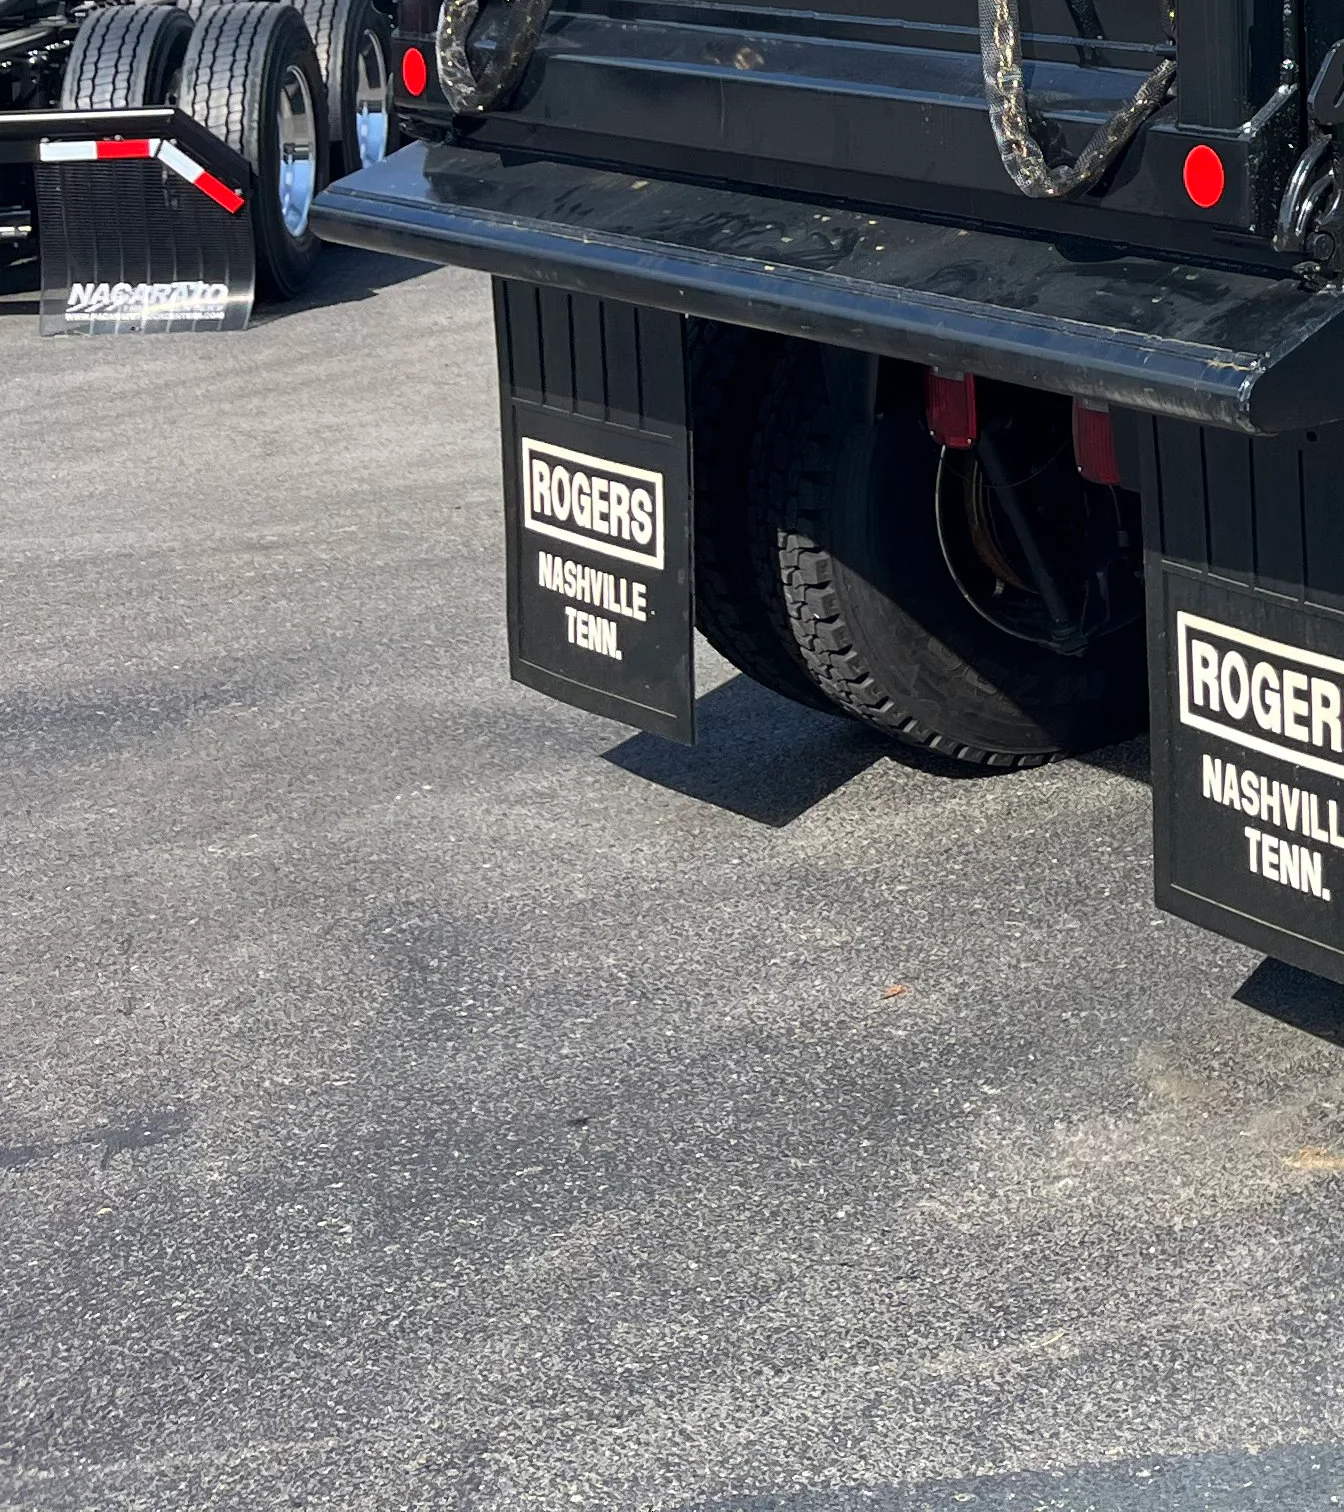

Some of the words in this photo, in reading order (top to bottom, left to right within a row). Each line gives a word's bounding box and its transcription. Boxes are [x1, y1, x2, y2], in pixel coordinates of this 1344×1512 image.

[531, 458, 653, 546] ROGERS
[538, 551, 648, 622] NASHVILLE
[565, 606, 623, 661] TENN.
[1244, 826, 1332, 903] TENN.
